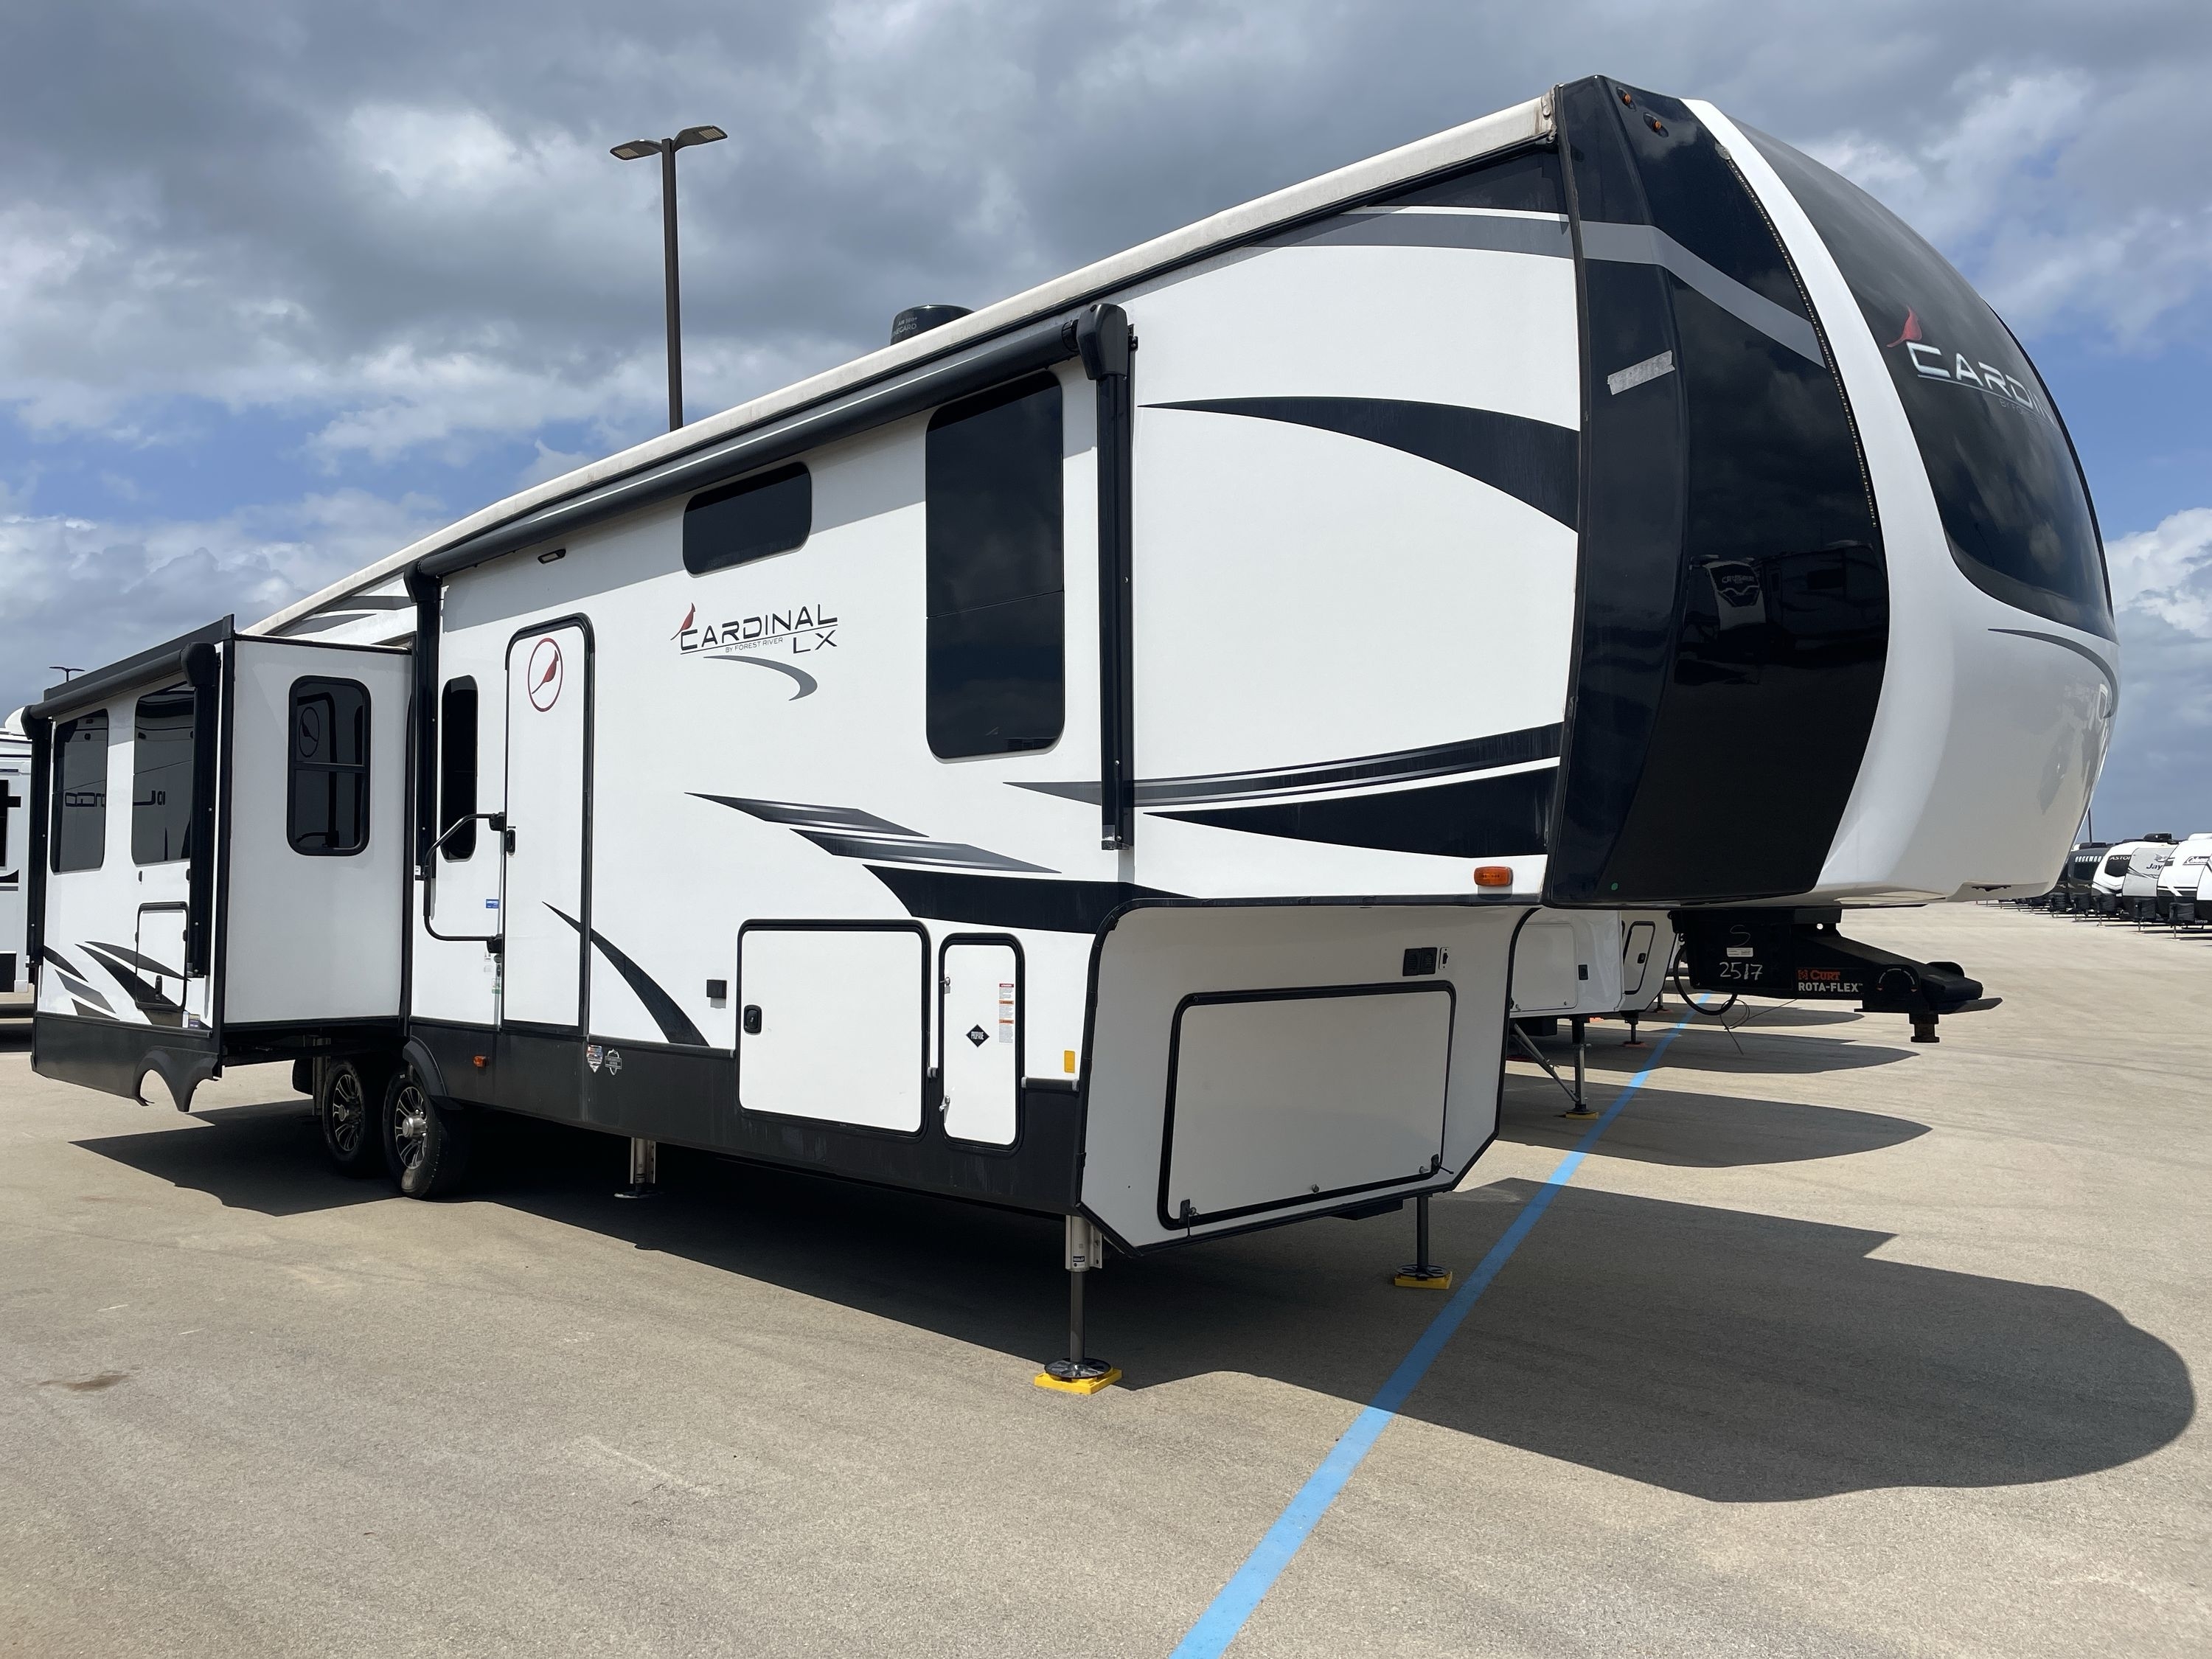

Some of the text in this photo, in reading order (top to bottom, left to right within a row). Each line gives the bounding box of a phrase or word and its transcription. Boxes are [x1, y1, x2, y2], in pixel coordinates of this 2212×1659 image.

[681, 603, 838, 651] CARDINAL
[734, 641, 761, 650] FOREST
[762, 637, 784, 646] RIVER
[793, 630, 838, 654] LX
[1719, 961, 1763, 981] 2517
